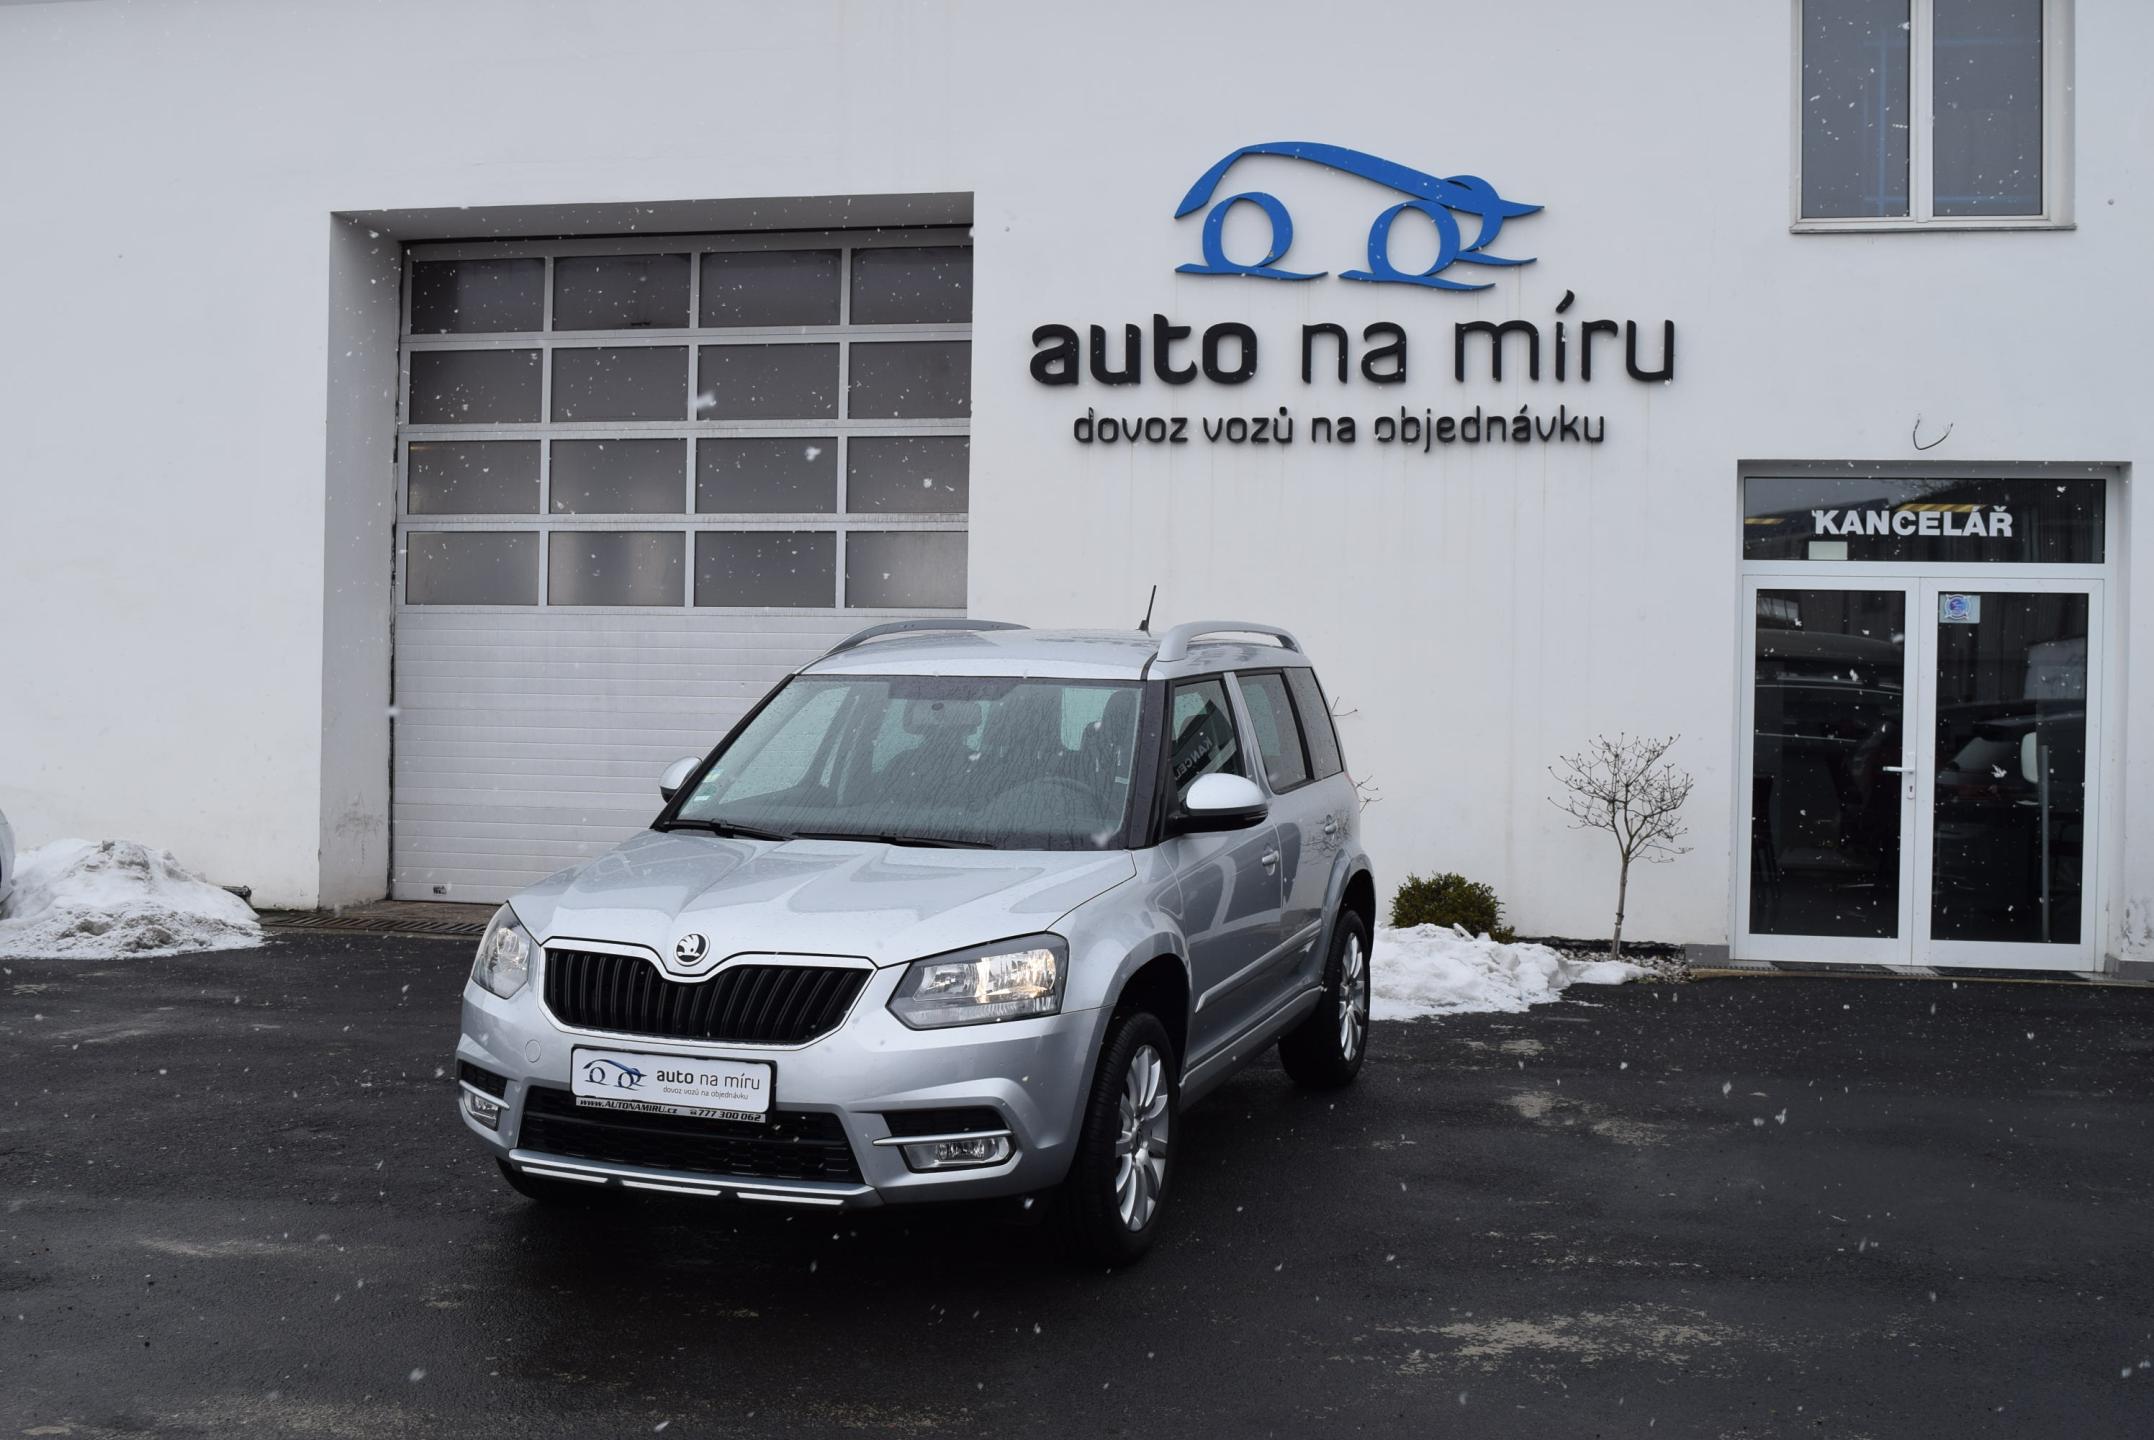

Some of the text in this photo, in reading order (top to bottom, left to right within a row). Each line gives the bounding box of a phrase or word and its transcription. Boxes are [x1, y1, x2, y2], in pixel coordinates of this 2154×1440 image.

[1029, 289, 1675, 385] auto na míru
[1073, 404, 1605, 453] dovoz vozů na objednávku
[1812, 505, 2013, 537] KANCELÁŘ
[656, 1070, 760, 1090] auto na míru
[663, 1085, 682, 1095] dovoz
[580, 1099, 678, 1114] www.AUTONAMIRU.cz
[698, 1109, 717, 1118] 777
[719, 1111, 738, 1120] 300
